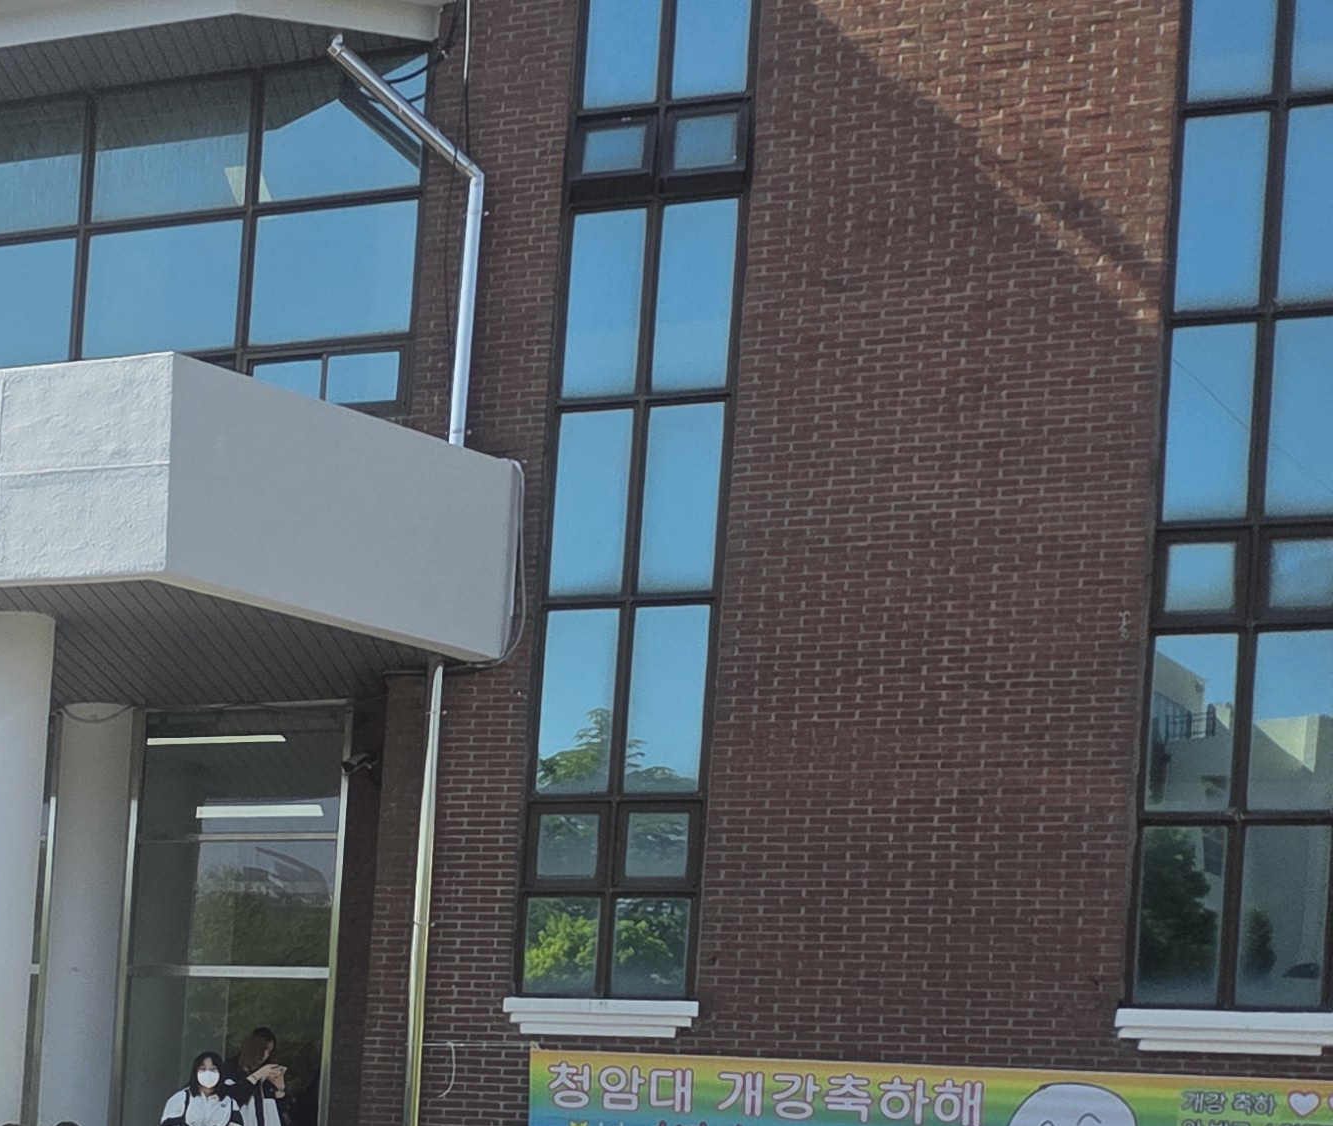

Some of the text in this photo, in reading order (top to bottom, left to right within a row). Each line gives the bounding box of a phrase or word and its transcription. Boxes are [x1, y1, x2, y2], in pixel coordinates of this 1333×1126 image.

[548, 1060, 693, 1114] 청암대
[1181, 1091, 1277, 1117] 개강 축하
